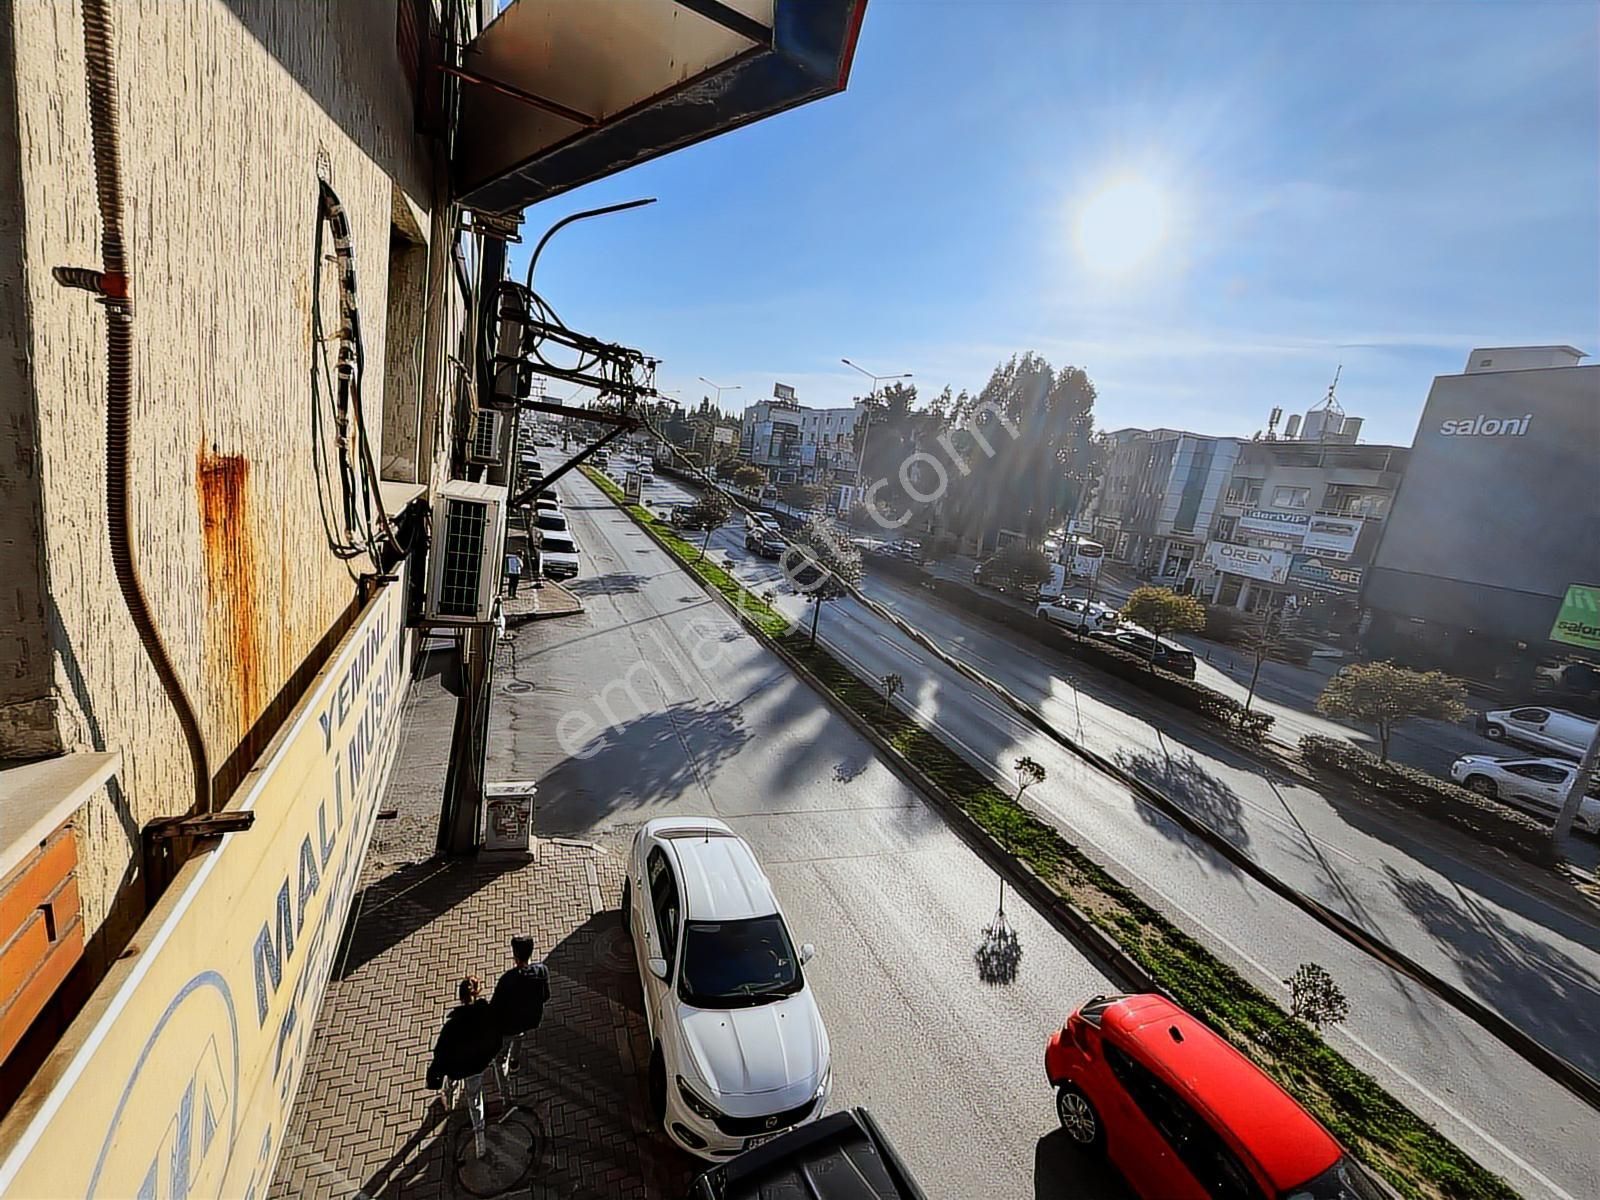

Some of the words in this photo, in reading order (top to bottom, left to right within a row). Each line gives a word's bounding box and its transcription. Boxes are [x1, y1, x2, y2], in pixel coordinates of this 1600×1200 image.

[1440, 414, 1533, 436] saloni
[1220, 544, 1273, 565] ÖREN
[318, 591, 391, 755] YEMİNLİ
[253, 750, 343, 1030] MALİ
[348, 621, 401, 802] MÜŞAVİ
